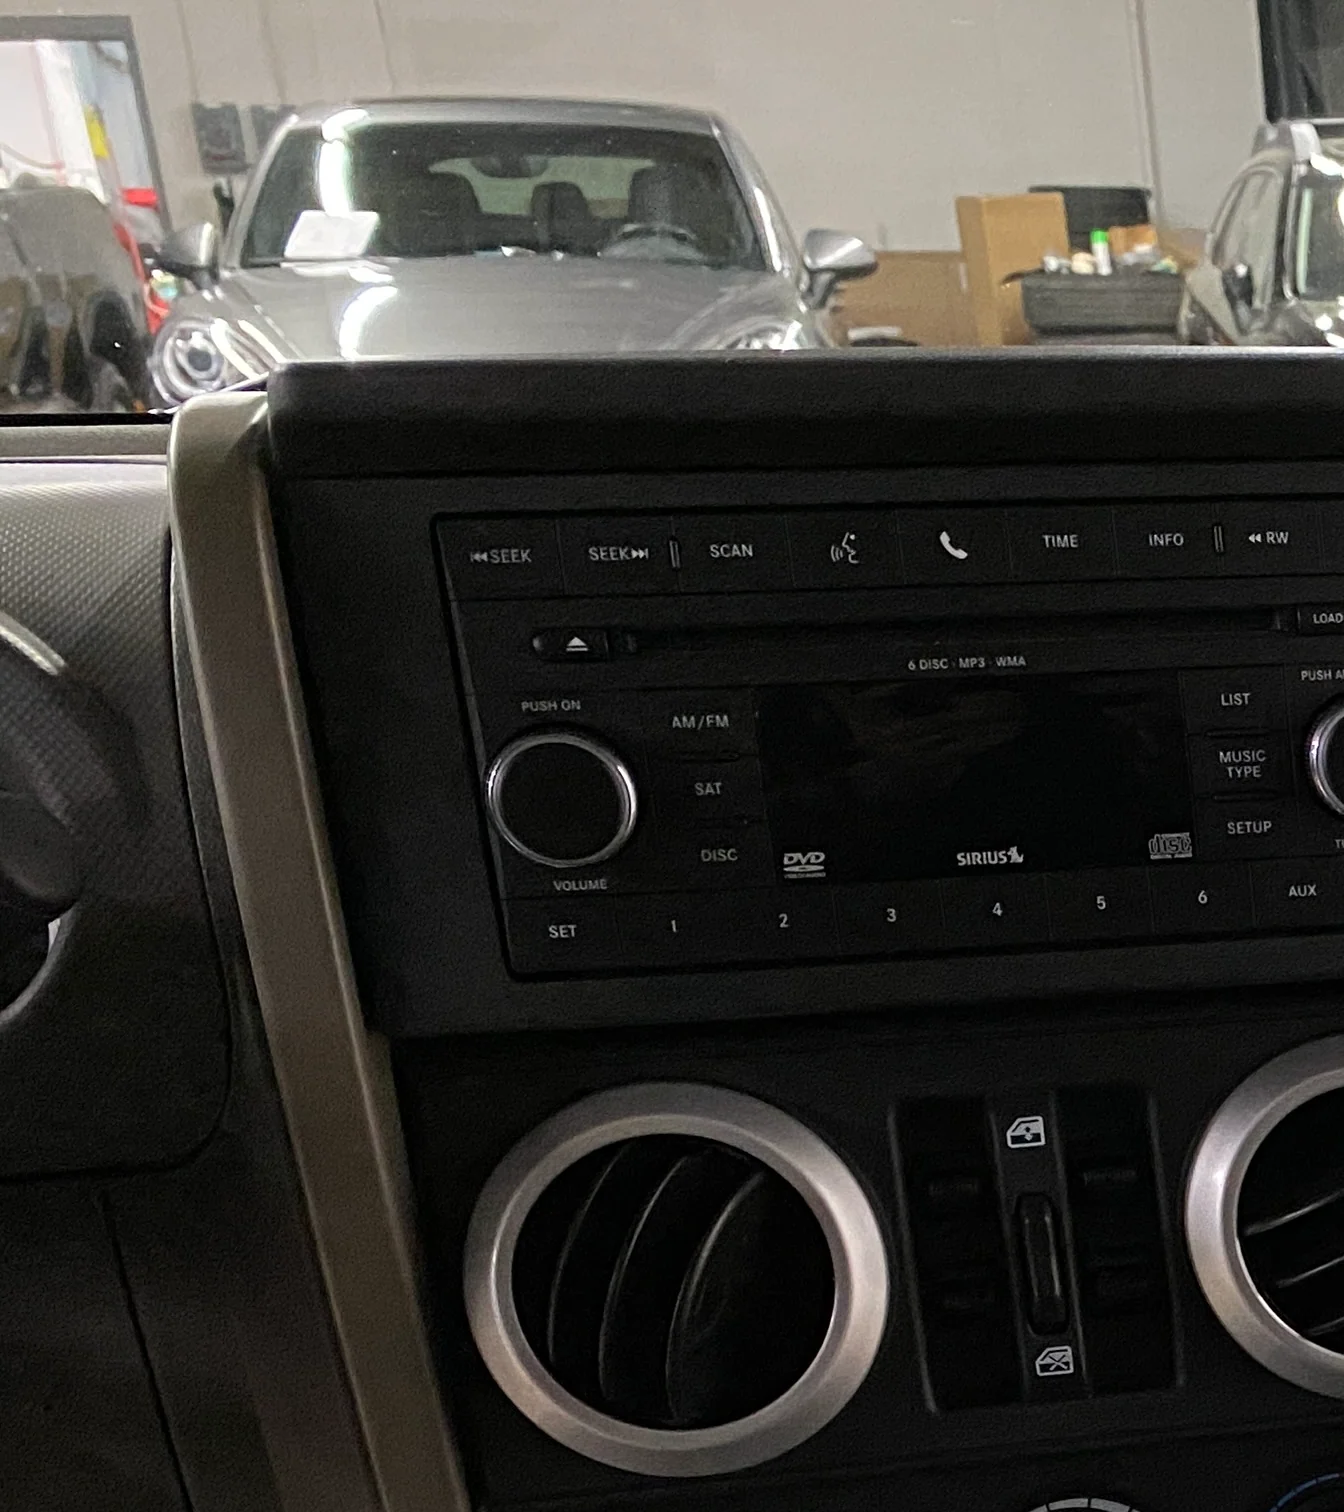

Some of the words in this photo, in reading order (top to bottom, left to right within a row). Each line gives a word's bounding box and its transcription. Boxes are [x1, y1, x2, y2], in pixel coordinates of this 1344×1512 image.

[1042, 533, 1078, 549] TIME
[1148, 532, 1184, 547] INFO
[1266, 531, 1289, 545] RW
[490, 548, 531, 564] SEEK
[589, 546, 630, 562] SEEK
[710, 544, 753, 559] SCAN
[1312, 611, 1344, 625] LOAD
[908, 660, 915, 671] 6
[919, 658, 949, 672] DISC
[958, 656, 986, 670] MP3
[995, 654, 1026, 668] WMA
[1301, 669, 1332, 681] PUSH
[521, 700, 558, 713] PUSH
[561, 699, 581, 712] ON
[1220, 692, 1250, 706] LIST
[672, 714, 730, 730] AM/FM
[1219, 750, 1267, 764] MUSIC
[1227, 766, 1262, 778] TYPE
[694, 782, 722, 797] SAT
[1227, 820, 1272, 834] SETUP
[700, 848, 738, 863] DISC
[783, 851, 826, 865] DVD
[956, 850, 1008, 866] SIRIUS
[554, 878, 608, 892] VOLUME
[1288, 885, 1317, 897] AUX
[1097, 896, 1106, 910] 5
[1198, 890, 1208, 904] 6
[887, 908, 897, 923] 3
[992, 902, 1002, 916] 4
[671, 920, 676, 932] 1
[778, 914, 789, 928] 2
[548, 924, 577, 938] SET
